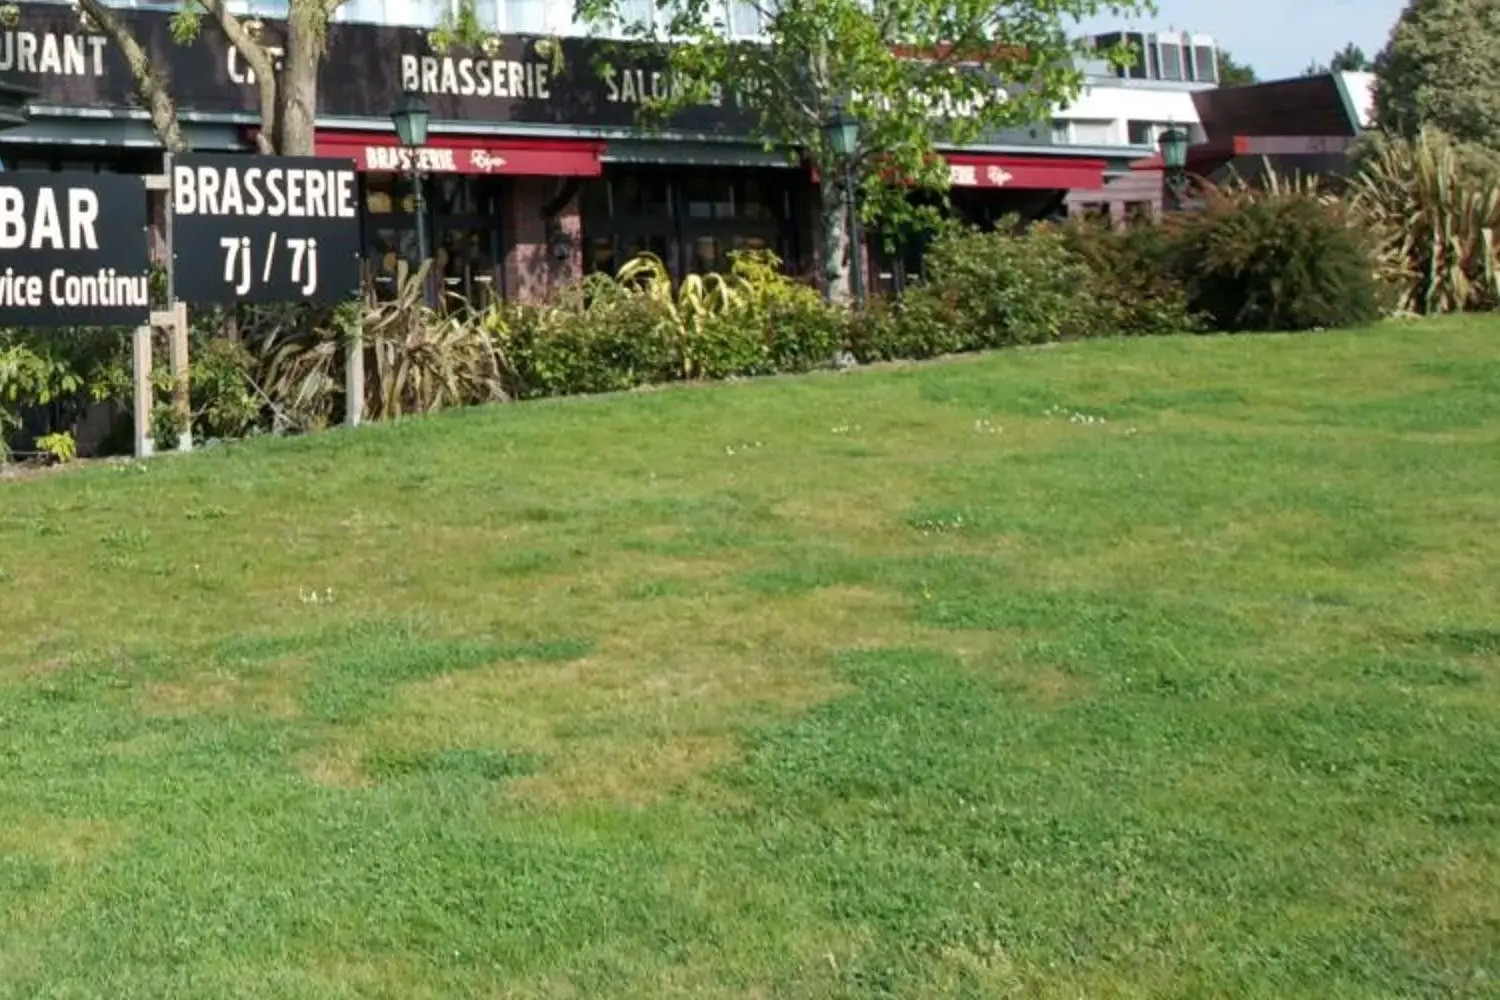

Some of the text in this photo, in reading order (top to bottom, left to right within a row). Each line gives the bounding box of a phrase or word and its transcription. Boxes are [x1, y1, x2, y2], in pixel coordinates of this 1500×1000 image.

[400, 54, 551, 99] BRASSERIE
[364, 145, 457, 171] BRASERIE
[173, 165, 356, 218] BRASSERIE
[49, 267, 149, 307] Continu
[220, 236, 251, 296] 7j
[286, 236, 317, 296] 7j
